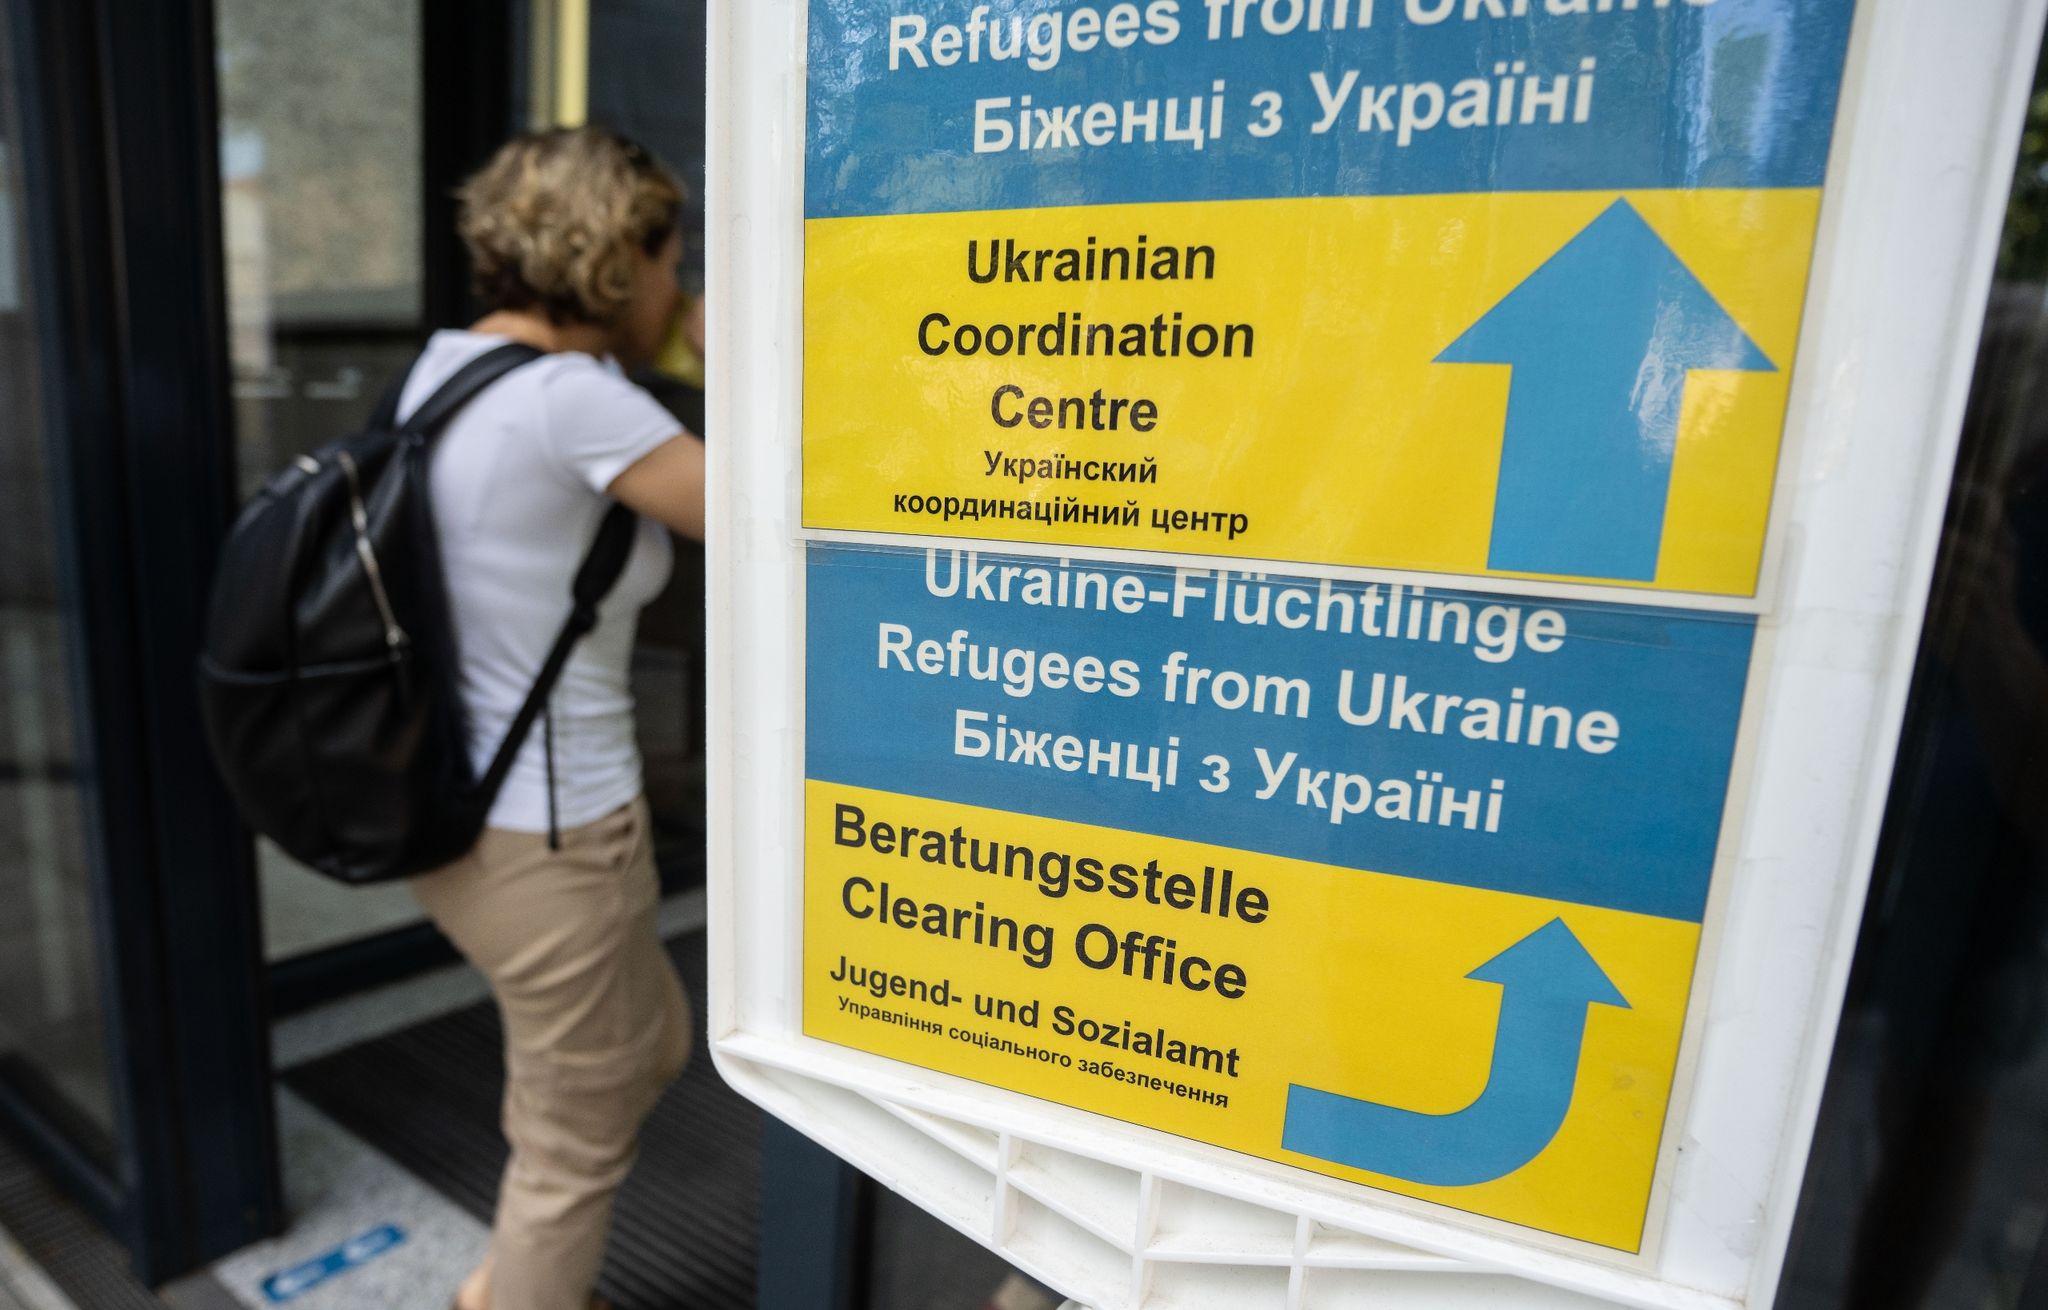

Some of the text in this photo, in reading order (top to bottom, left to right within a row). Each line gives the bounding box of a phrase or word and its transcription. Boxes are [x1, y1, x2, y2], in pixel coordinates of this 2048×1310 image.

[888, 0, 1181, 71] Refugees
[973, 57, 1596, 154] Біженці з Україні
[967, 235, 1215, 284] Ukrainian
[917, 312, 1254, 358] Coordination
[991, 384, 1158, 432] Centre
[893, 493, 1249, 540] координаційний центр
[984, 450, 1157, 483] Українский
[925, 548, 1567, 664] Ukraine-Flüchtlinge
[878, 622, 1620, 754] Refugees from Ukraine
[954, 708, 1505, 833] Біженці з Україні
[834, 802, 1270, 924] Beratungsstelle
[841, 876, 1248, 1000] Clearing Office
[830, 955, 1240, 1078] Jugend- und Sozialamt
[838, 995, 1230, 1109] Управління соціального забезпечення
